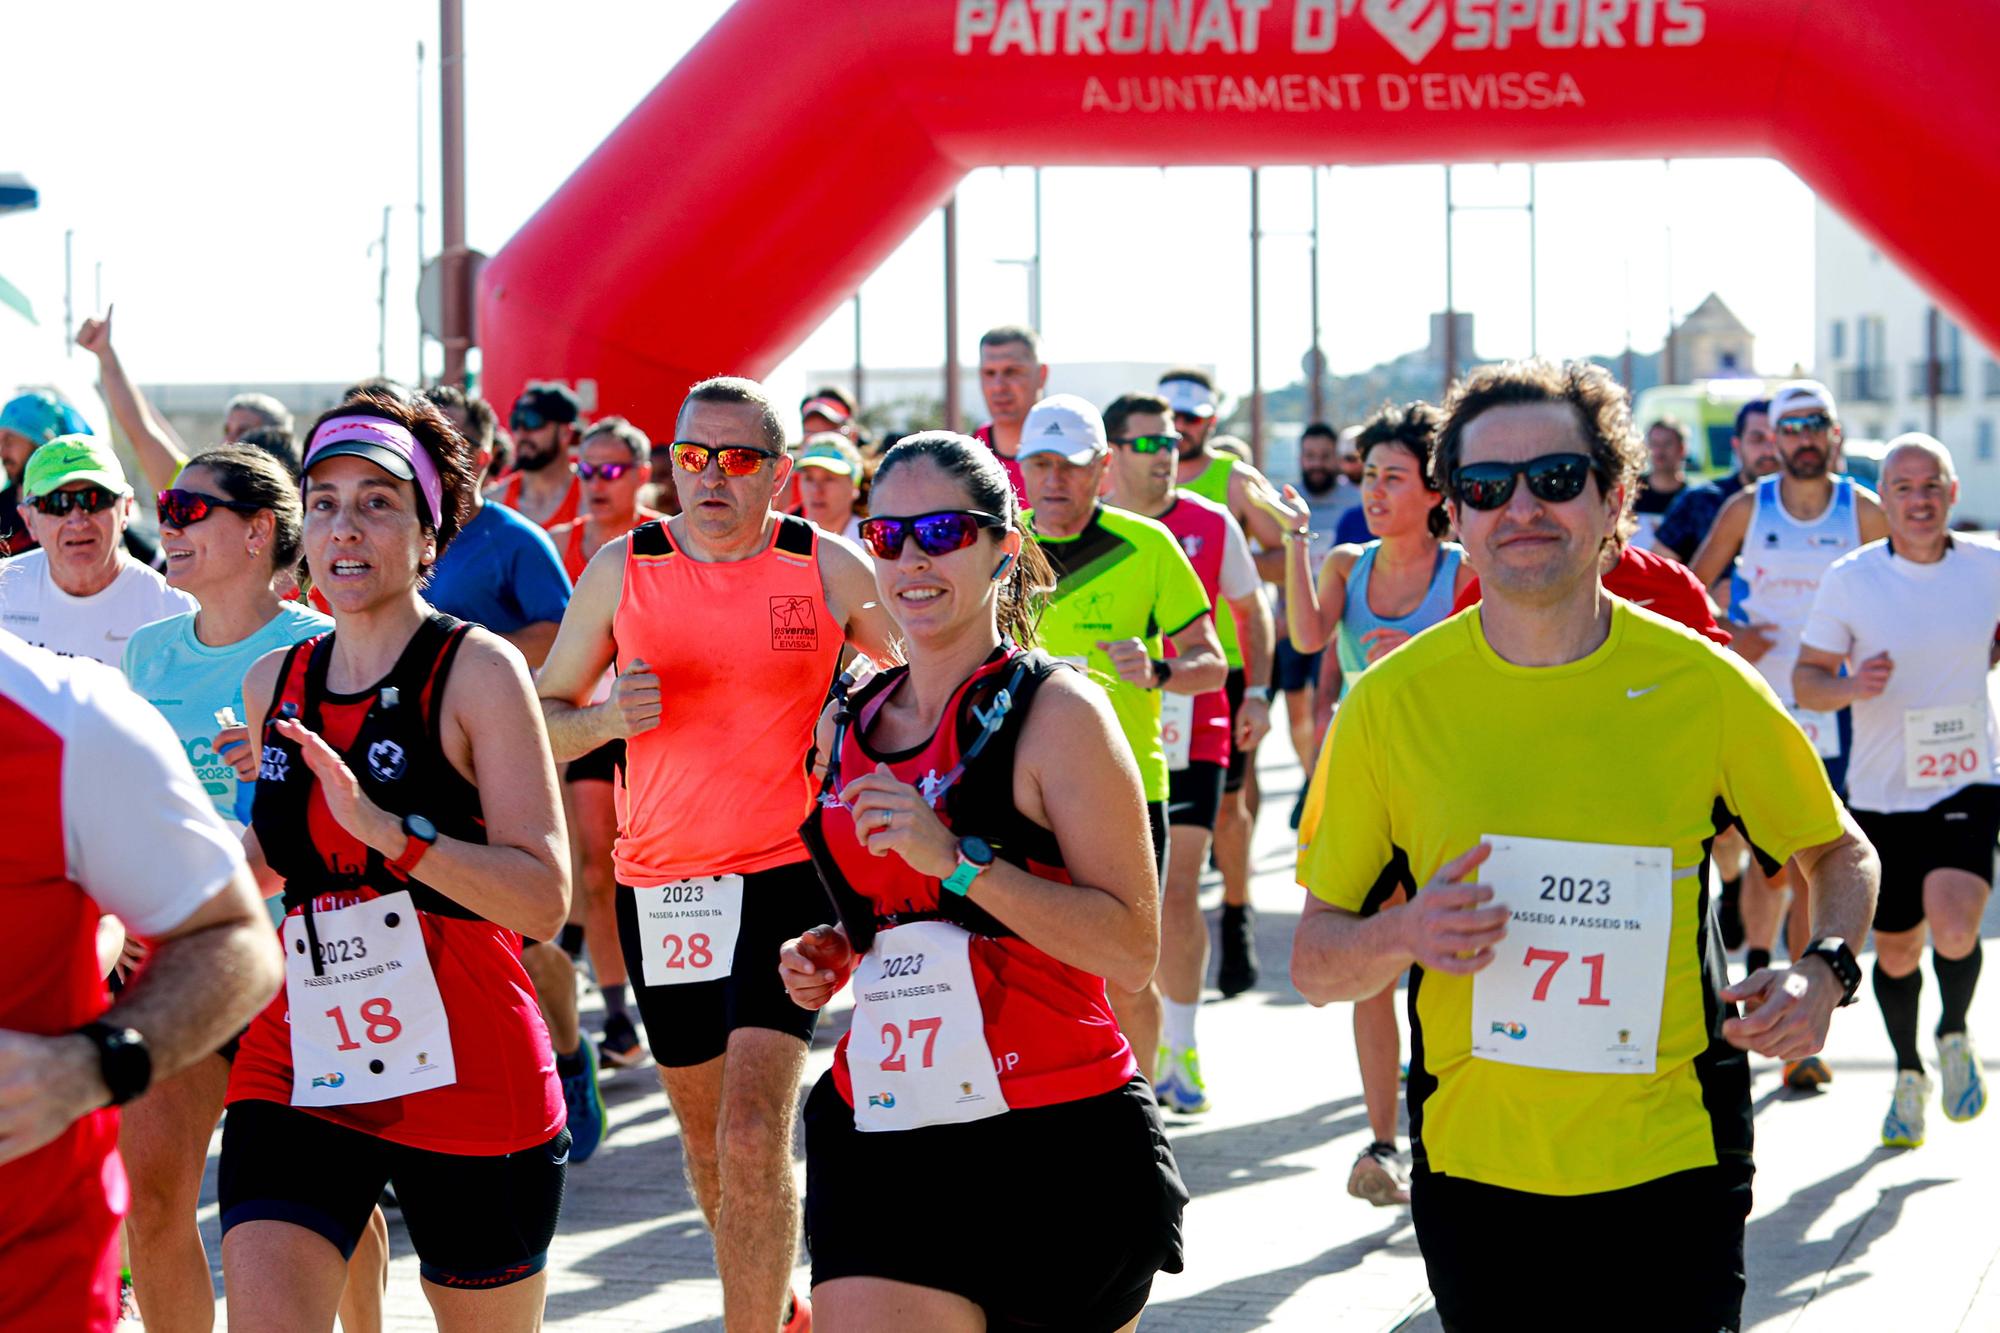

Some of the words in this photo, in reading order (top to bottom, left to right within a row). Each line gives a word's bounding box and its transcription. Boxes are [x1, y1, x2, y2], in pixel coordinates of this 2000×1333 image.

[954, 0, 1271, 55] PATRONAT
[1081, 74, 1365, 112] AJUNTAMENT
[1377, 71, 1586, 111] D'EIVISSA
[196, 767, 234, 780] 2023
[1917, 747, 1979, 777] 220
[663, 886, 704, 903] 2023
[1540, 875, 1611, 905] 2023
[649, 911, 673, 919] PASSEIG
[681, 910, 710, 918] PASSEIG
[1509, 910, 1555, 925] ASSEIG
[1559, 916, 1567, 926] A
[1570, 916, 1621, 930] PASSEIG
[1624, 920, 1641, 930] 15k
[318, 936, 367, 966] 2023
[662, 933, 713, 969] 28
[335, 975, 341, 984] A
[342, 965, 384, 982] PASSEIG
[1523, 946, 1610, 1006] 71
[864, 990, 889, 1002] PASSEIG
[891, 990, 896, 999] A
[898, 985, 935, 998] PASSEIG
[325, 997, 402, 1051] 18
[880, 1016, 943, 1072] 27
